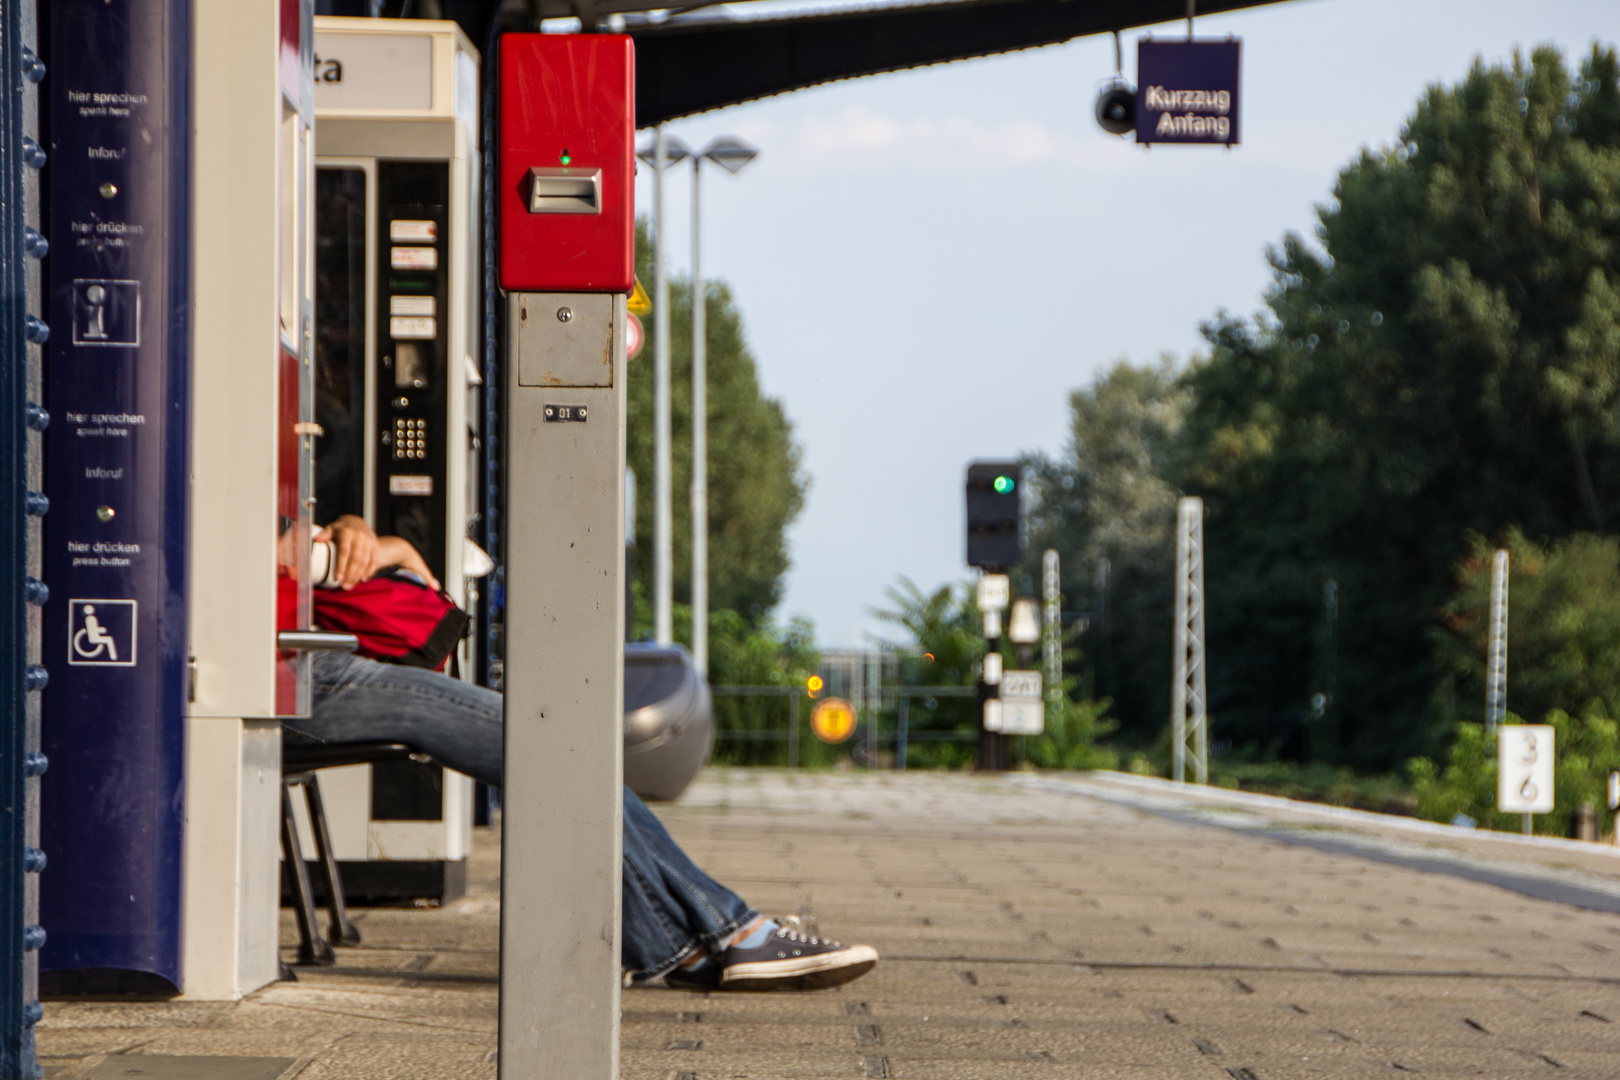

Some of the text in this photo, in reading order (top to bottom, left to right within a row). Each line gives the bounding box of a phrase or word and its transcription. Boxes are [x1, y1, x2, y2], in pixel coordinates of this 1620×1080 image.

[68, 90, 148, 105] hier sprechen
[1145, 85, 1231, 115] Kurzzug
[1156, 112, 1230, 141] Anfang
[71, 221, 144, 235] hier drücken
[66, 411, 146, 426] hier sprechen
[558, 408, 571, 419] 01
[85, 467, 124, 480] Inforuf
[67, 541, 141, 554] hier drücken
[72, 556, 130, 568] press button
[1520, 731, 1538, 765] 3
[1519, 771, 1538, 803] 6
